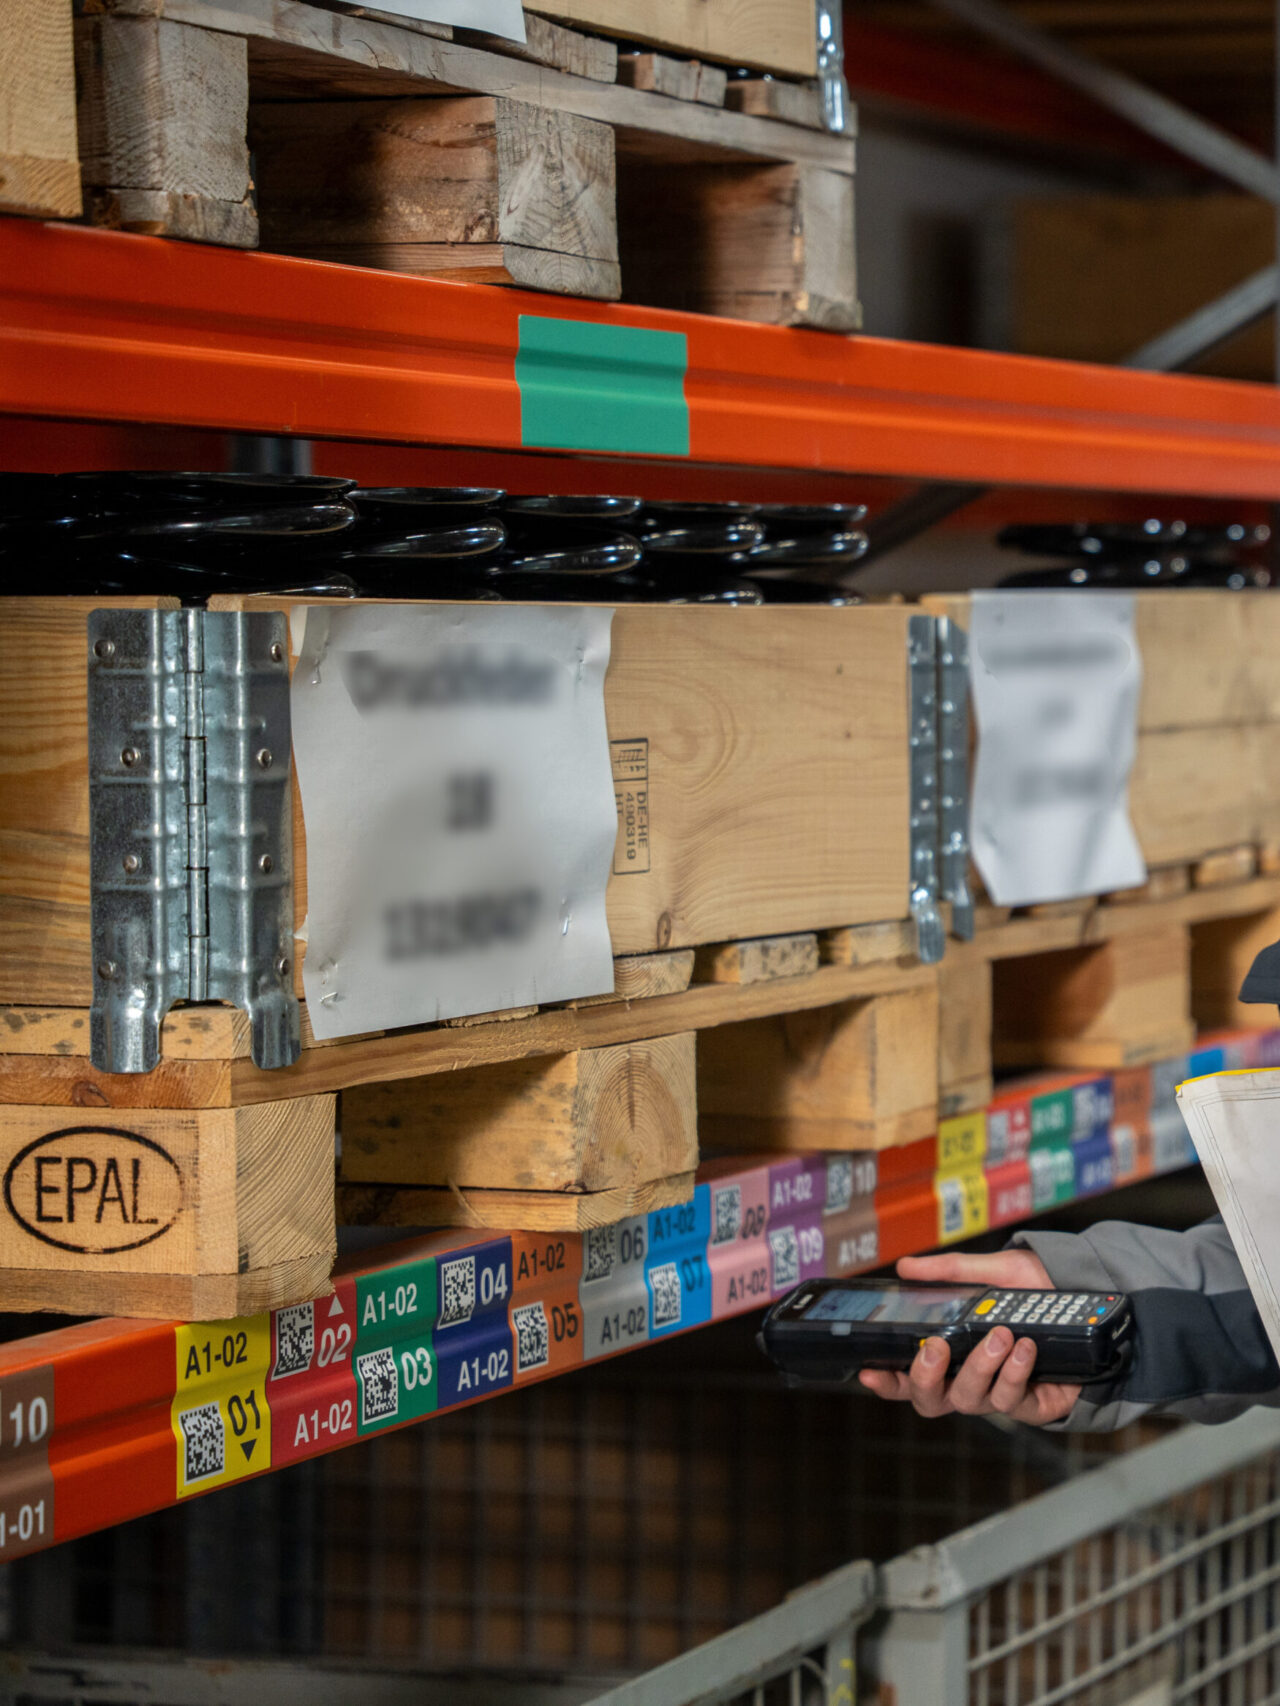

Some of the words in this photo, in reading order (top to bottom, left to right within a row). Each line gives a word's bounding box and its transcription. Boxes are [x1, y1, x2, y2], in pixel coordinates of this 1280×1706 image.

[637, 792, 648, 848] DE-HE
[34, 1156, 158, 1225] EPAL
[774, 1173, 813, 1207] A1-02
[621, 1225, 645, 1264] 06
[653, 1206, 696, 1243] A1-02
[799, 1226, 824, 1264] 09
[517, 1242, 566, 1281] A1-02
[681, 1255, 705, 1292] 07
[362, 1283, 418, 1326] A1-02
[480, 1263, 509, 1306] 04
[728, 1268, 768, 1303] A1-02
[551, 1302, 579, 1342] 05
[601, 1306, 646, 1345] A1-02
[185, 1331, 248, 1380] A1-02
[317, 1323, 352, 1368] 02
[401, 1347, 433, 1391] 03
[457, 1349, 509, 1392] A1-02
[9, 1396, 48, 1448] 10
[227, 1389, 261, 1437] 01
[294, 1399, 352, 1447] A1-02
